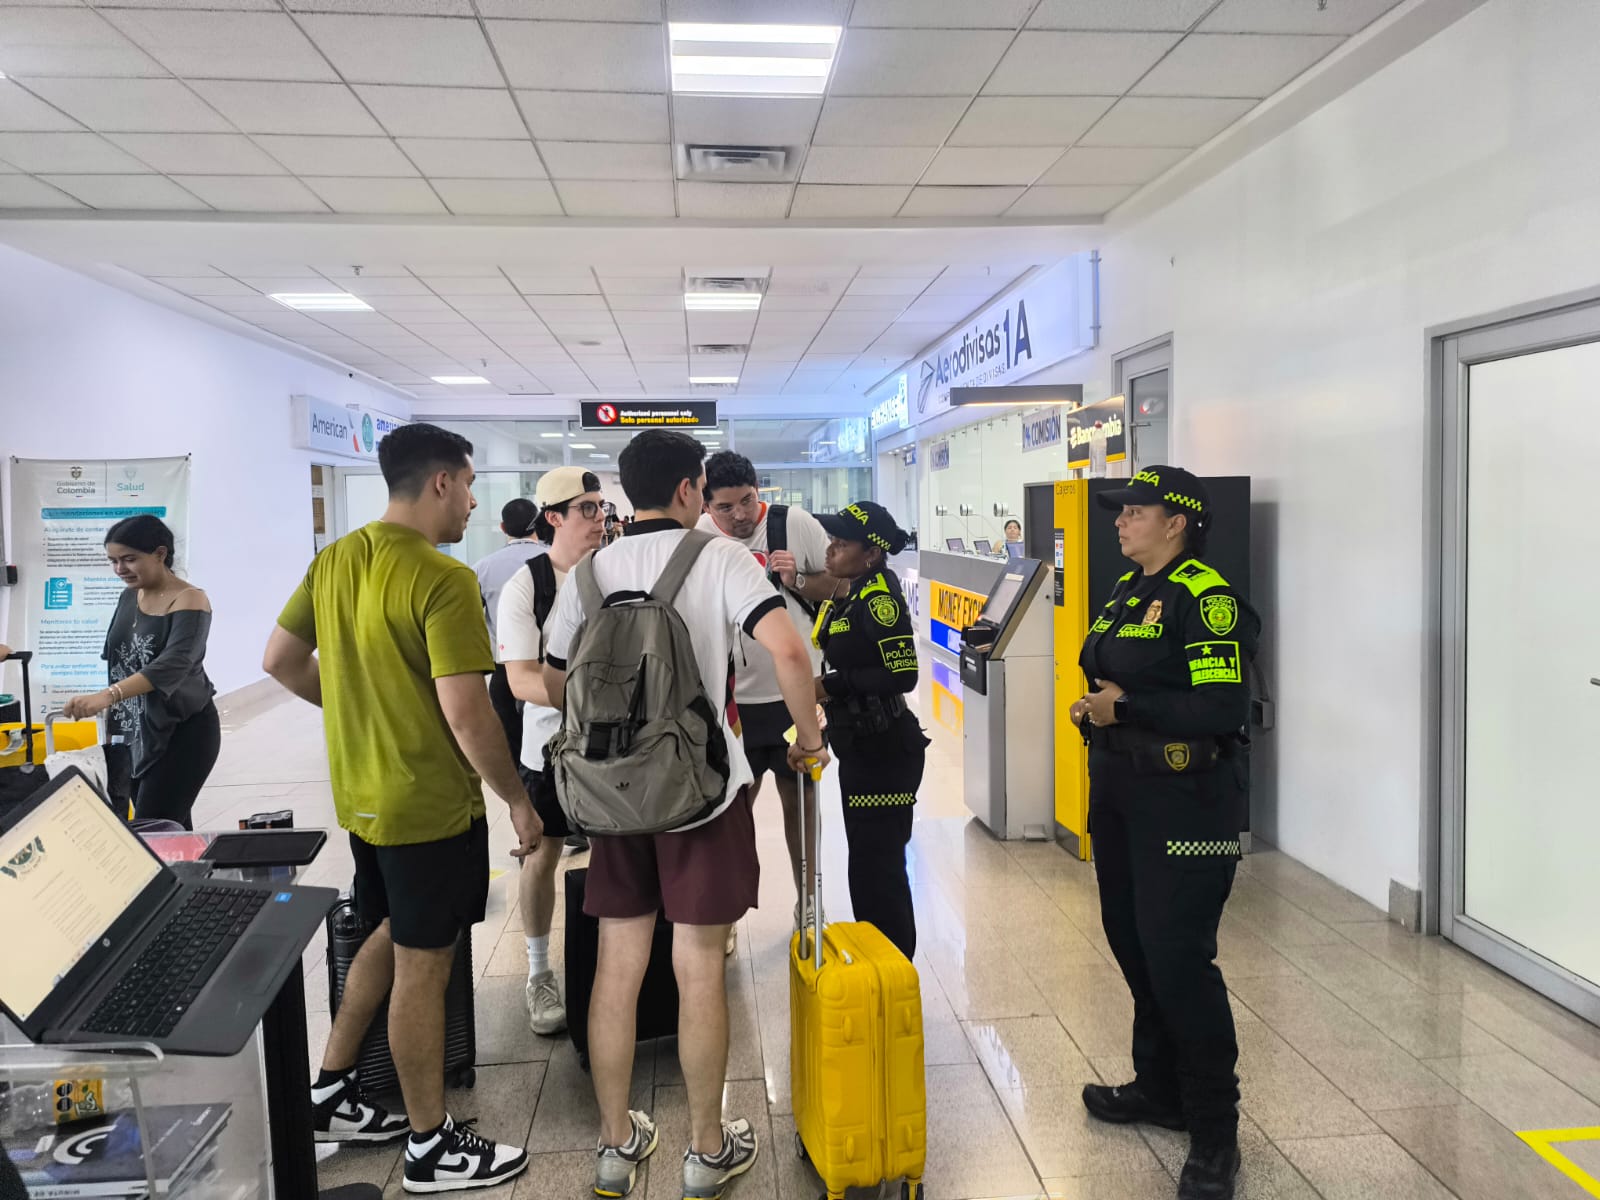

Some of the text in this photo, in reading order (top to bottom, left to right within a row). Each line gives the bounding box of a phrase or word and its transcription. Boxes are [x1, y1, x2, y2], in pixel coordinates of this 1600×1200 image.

[935, 299, 1032, 388] Aerodivisas 1A
[312, 412, 348, 440] American
[637, 416, 665, 425] personal
[666, 416, 700, 425] autorizado
[1031, 409, 1061, 446] COMISIÓN
[116, 482, 145, 492] Salud
[938, 587, 961, 626] MONEY
